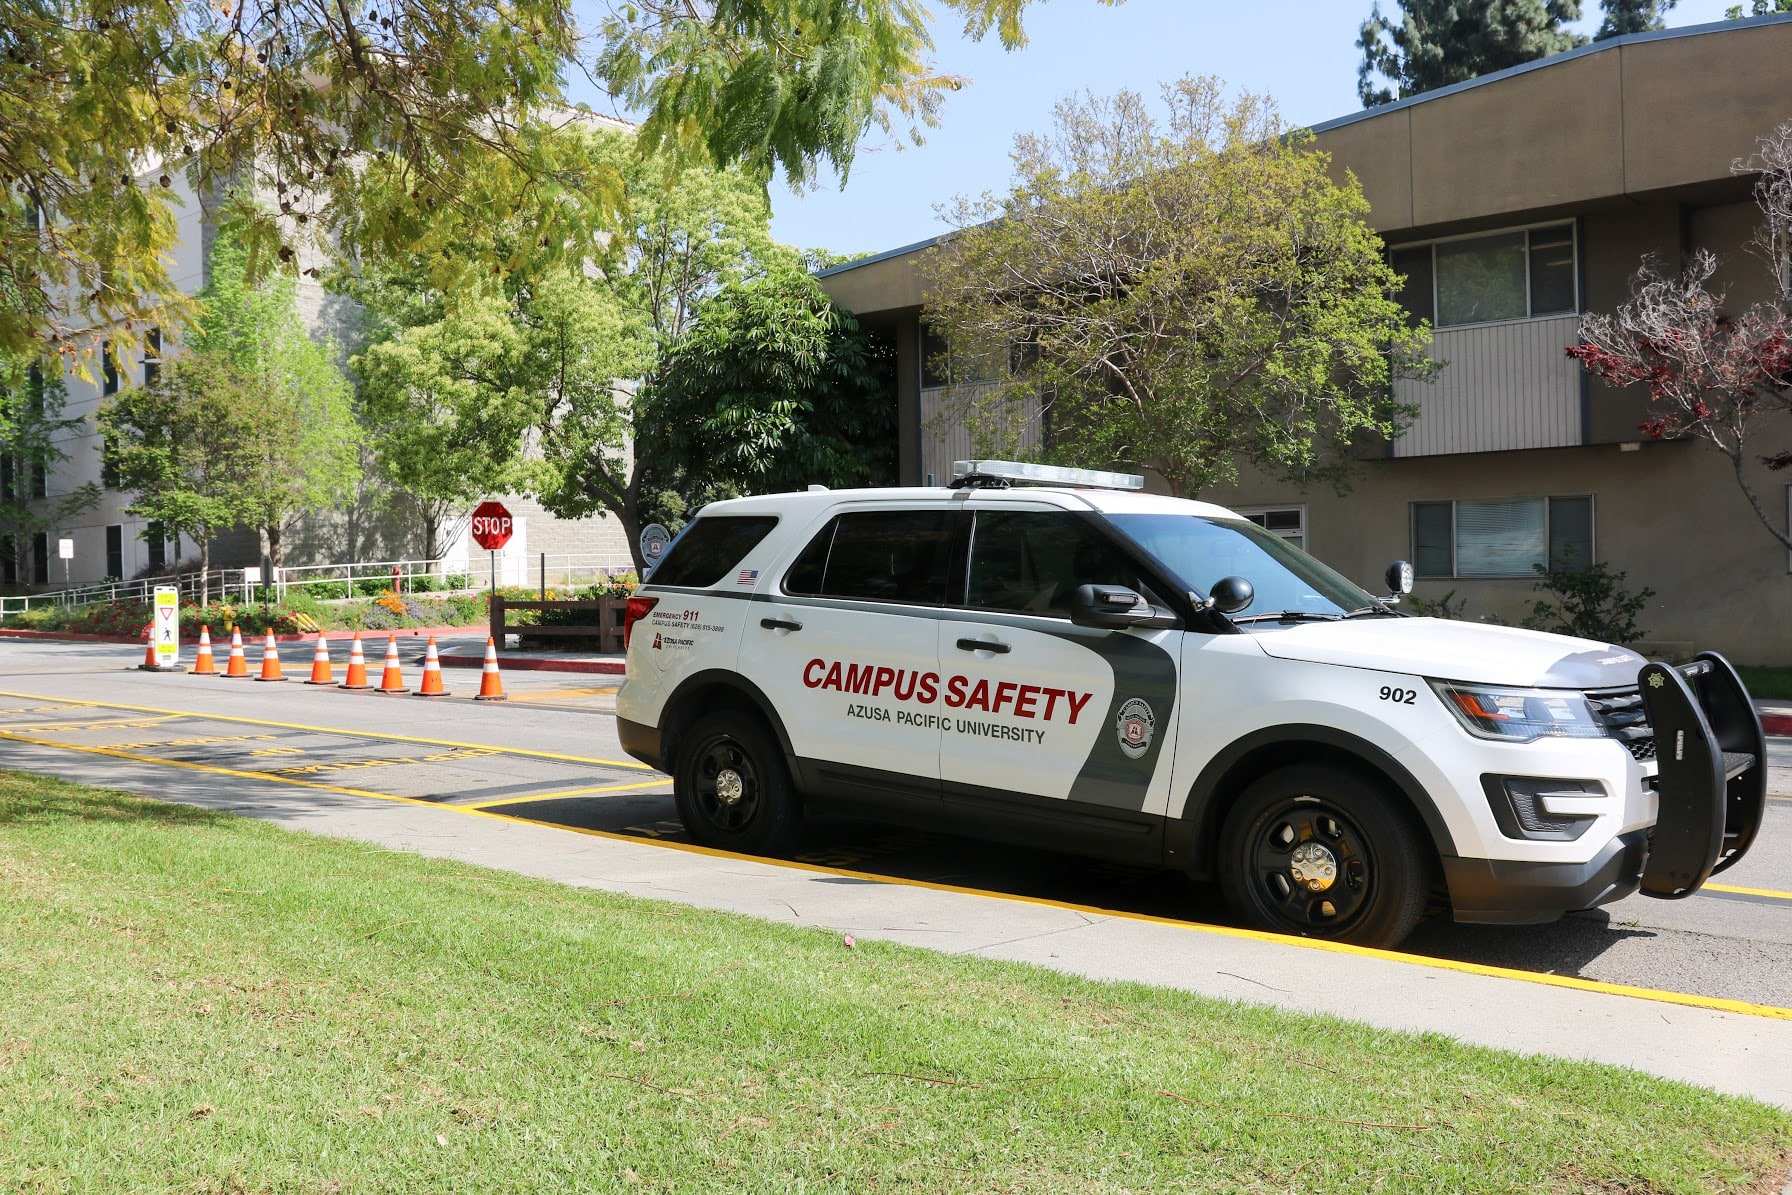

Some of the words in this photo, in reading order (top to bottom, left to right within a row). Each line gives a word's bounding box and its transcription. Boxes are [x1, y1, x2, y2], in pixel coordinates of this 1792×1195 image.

[473, 516, 511, 535] STOP
[653, 612, 681, 620] EMERGENCY
[683, 610, 699, 621] 911
[671, 621, 690, 629] SAFETY
[803, 658, 940, 703] CAMPUS
[944, 675, 1094, 725] SAFETY
[1379, 685, 1417, 705] 902
[847, 703, 891, 722] AZUSA
[897, 711, 951, 731] PACIFIC
[957, 720, 1046, 744] UNIVERSITY
